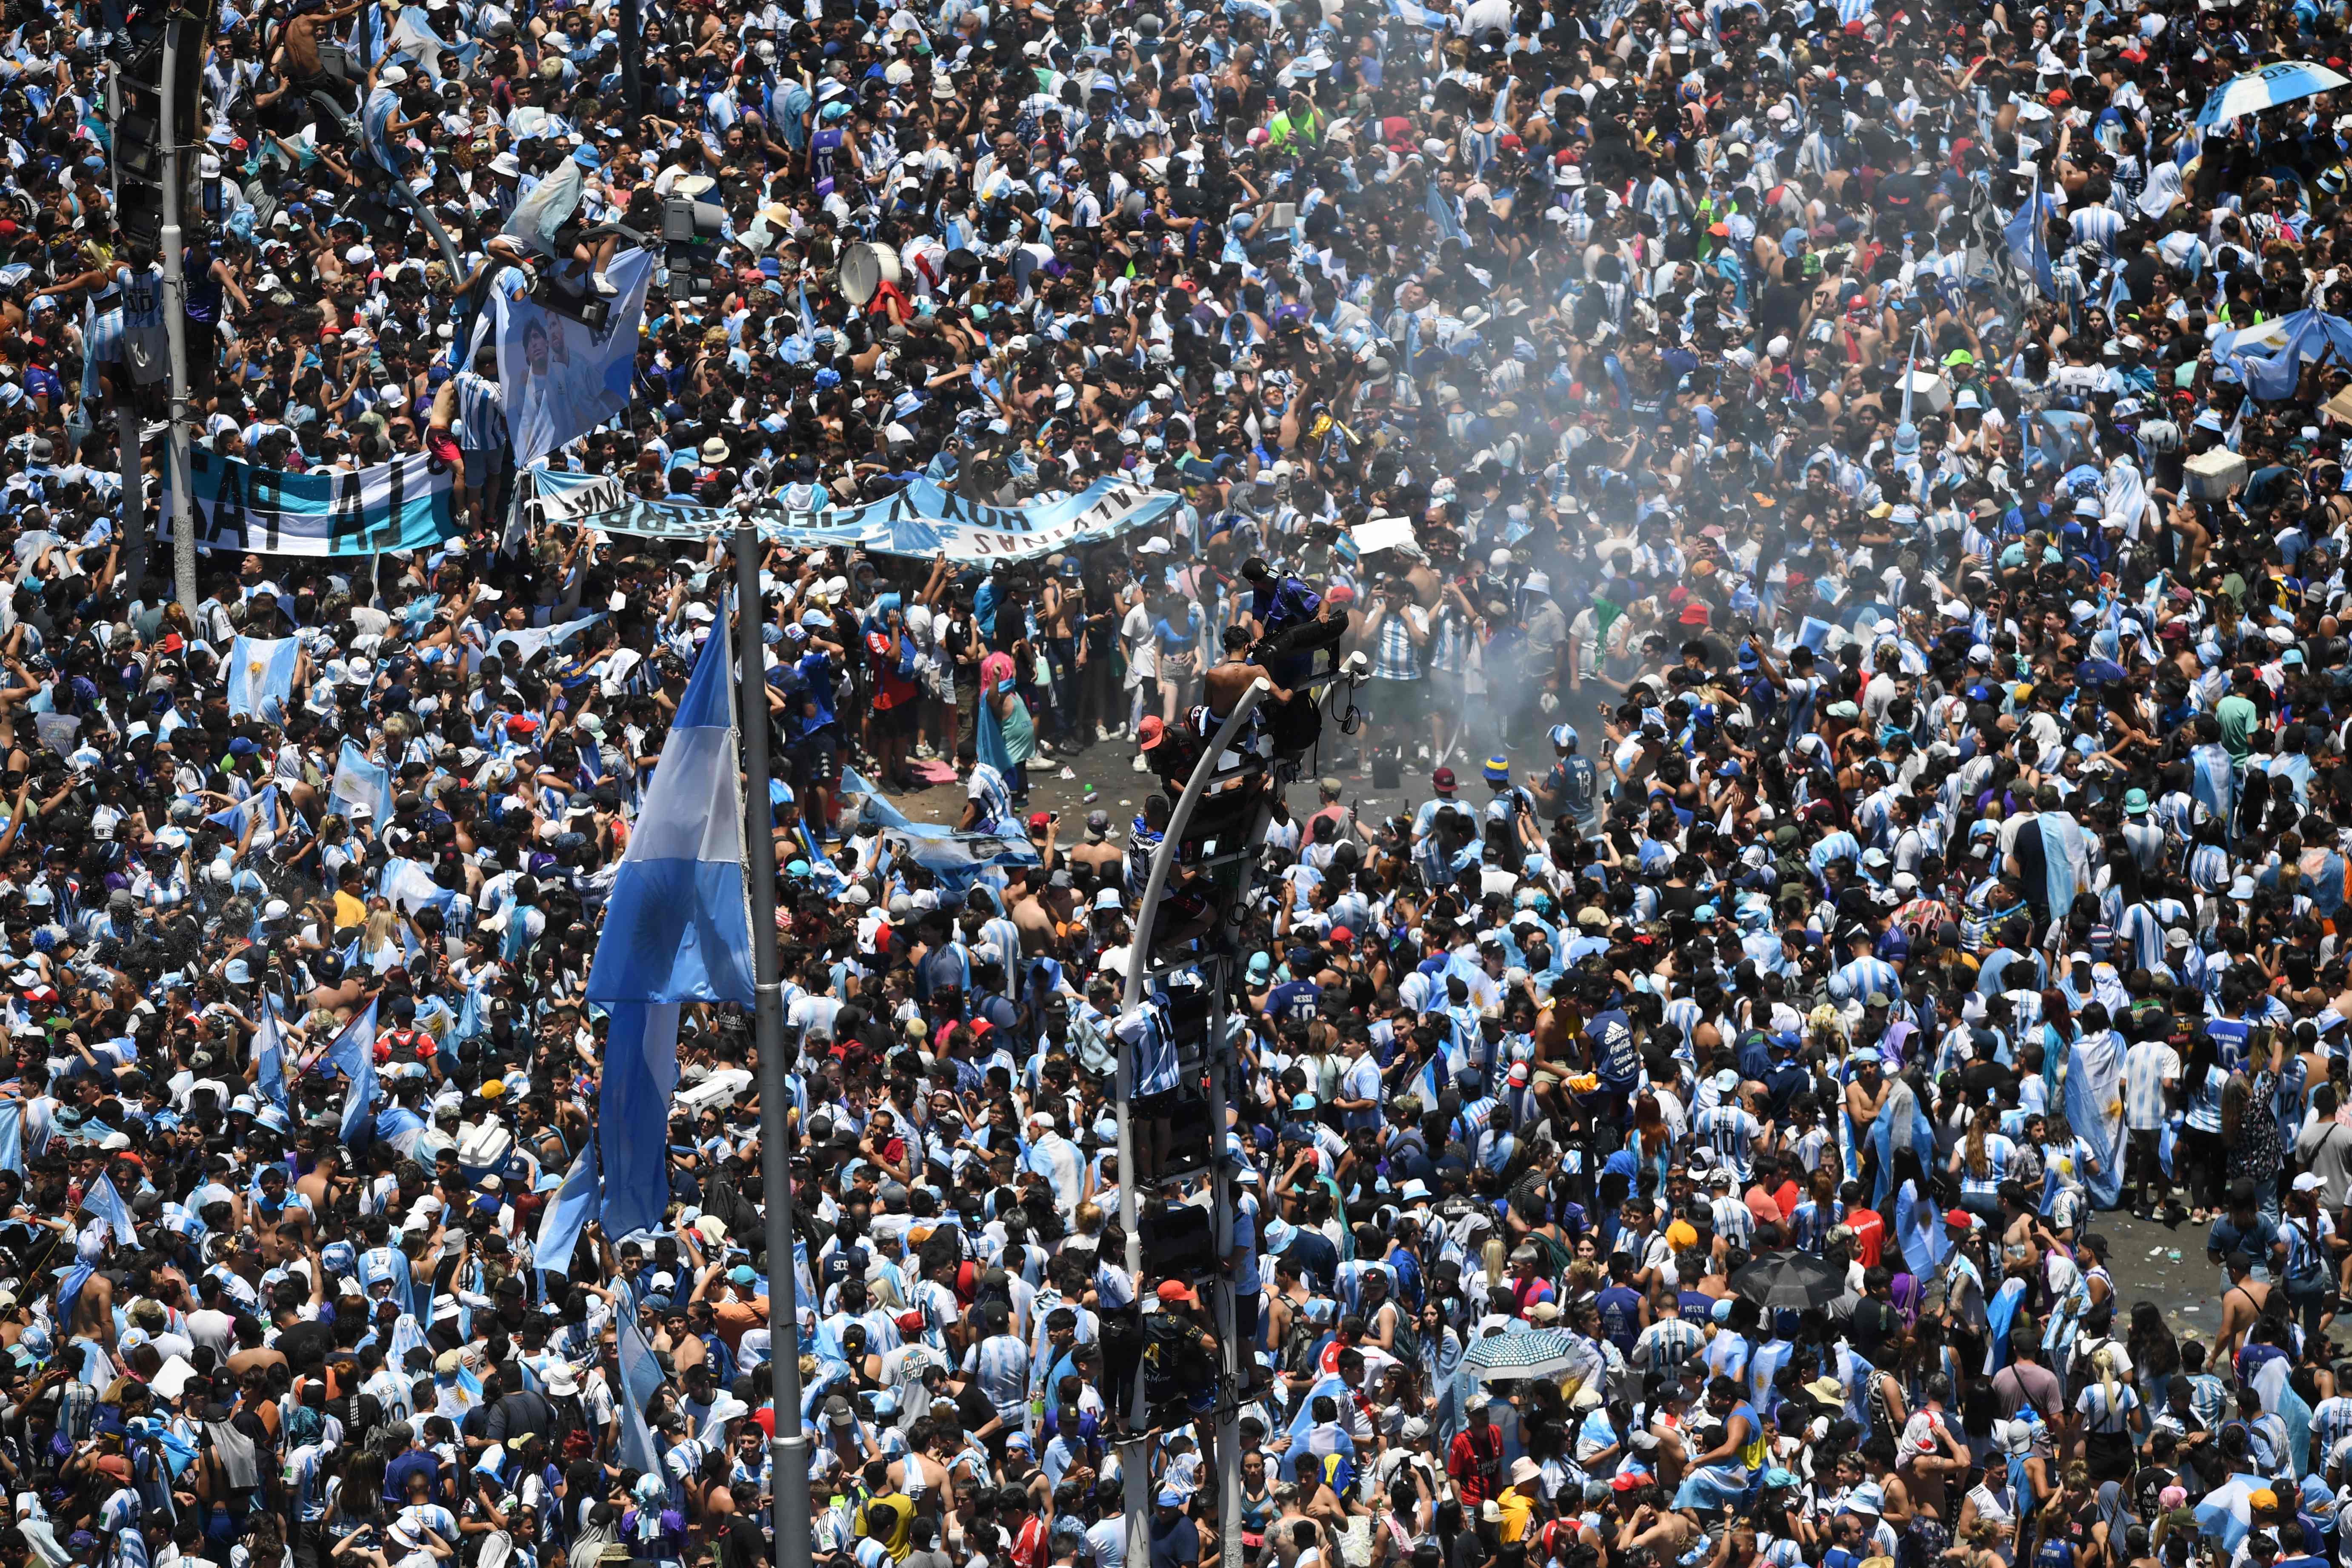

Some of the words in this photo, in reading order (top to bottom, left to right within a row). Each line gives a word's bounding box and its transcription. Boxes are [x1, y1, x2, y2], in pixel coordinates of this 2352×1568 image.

[942, 493, 1034, 531] HOY
[1292, 995, 1313, 1004] MESSI
[1150, 1002, 1175, 1047] 10
[1604, 1029, 1630, 1045] adidas
[1714, 1119, 1733, 1129] MESSI
[1711, 1129, 1735, 1156] 10
[1685, 1305, 1704, 1314] MESSI
[901, 1351, 929, 1374] SANTA
[907, 1365, 929, 1382] CRU
[377, 1384, 399, 1397] MESSI
